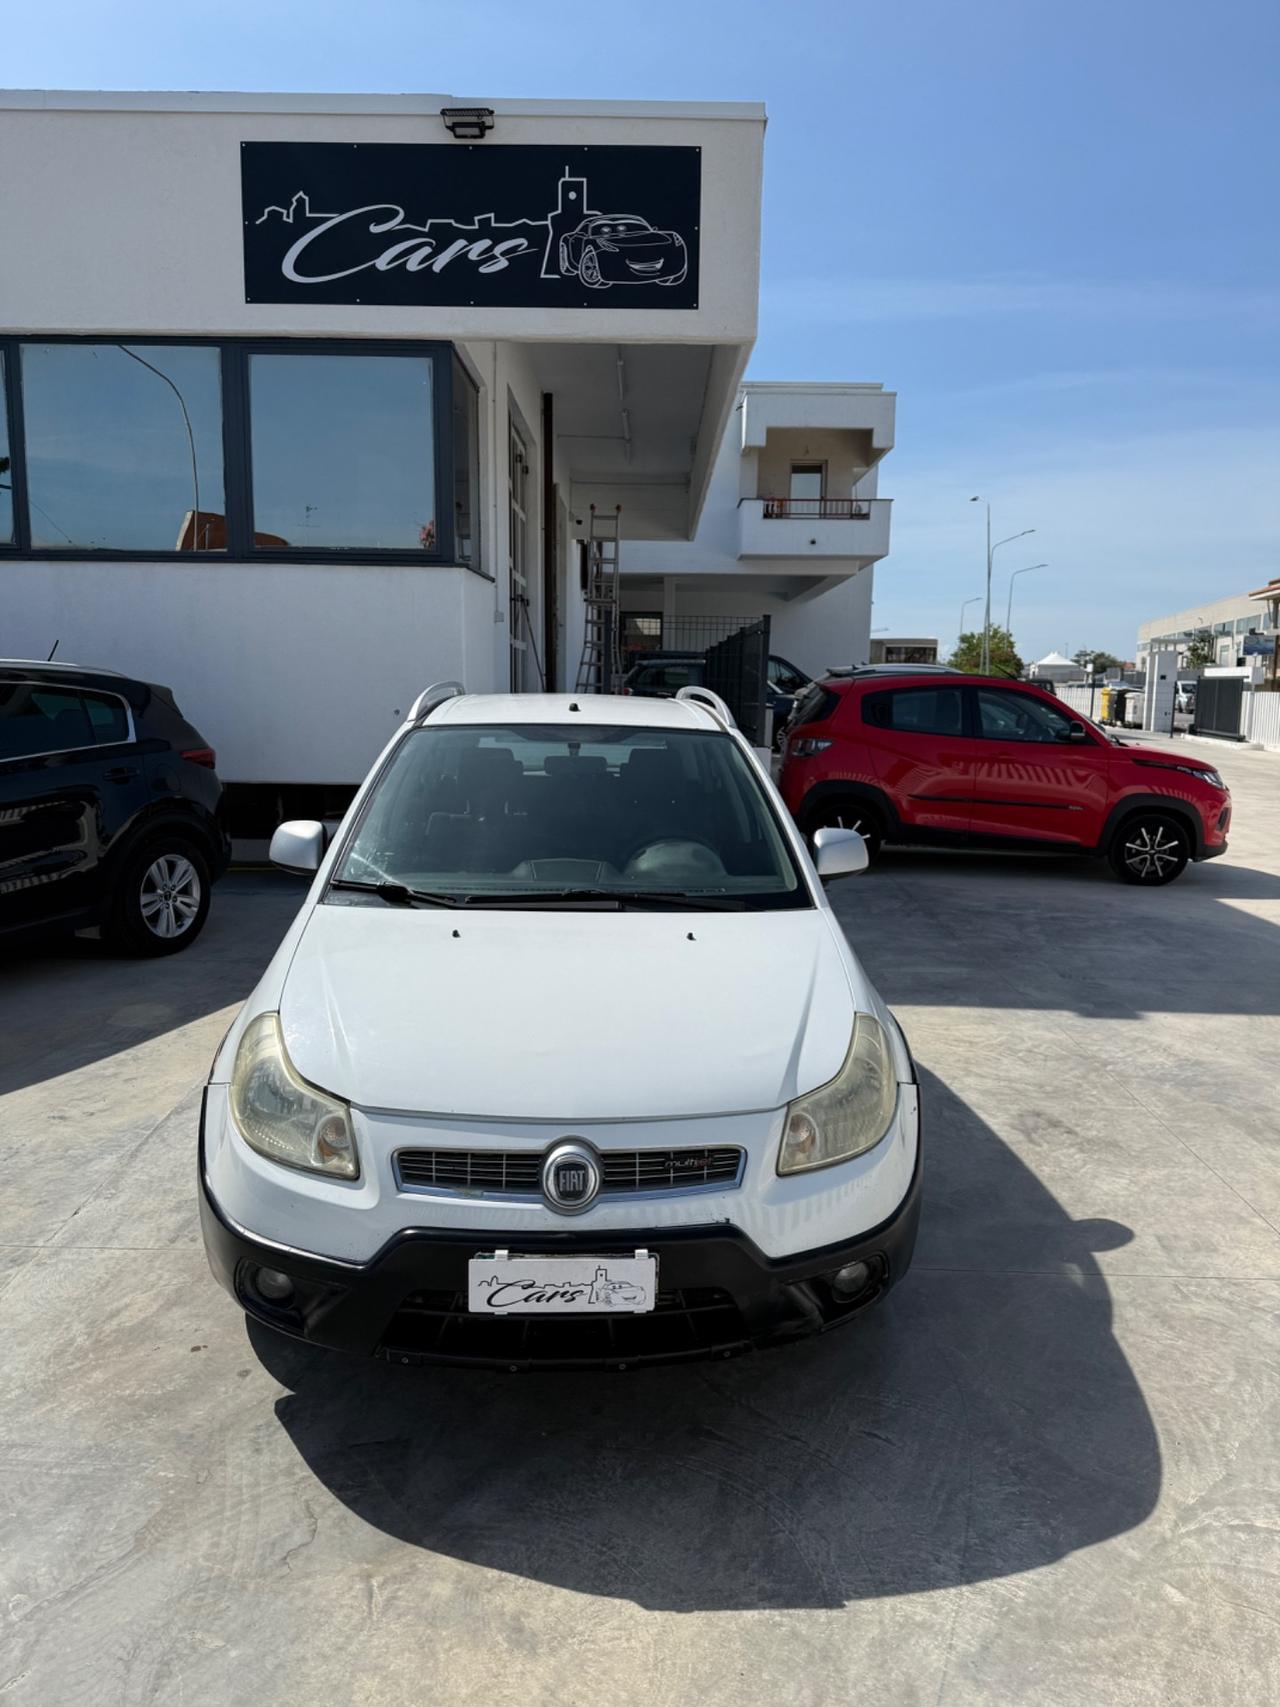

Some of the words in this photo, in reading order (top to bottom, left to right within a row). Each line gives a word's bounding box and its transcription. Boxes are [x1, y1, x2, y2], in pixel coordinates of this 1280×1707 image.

[281, 204, 538, 283] Cars
[560, 1170, 585, 1191] FIAT
[487, 1279, 584, 1307] Cars
